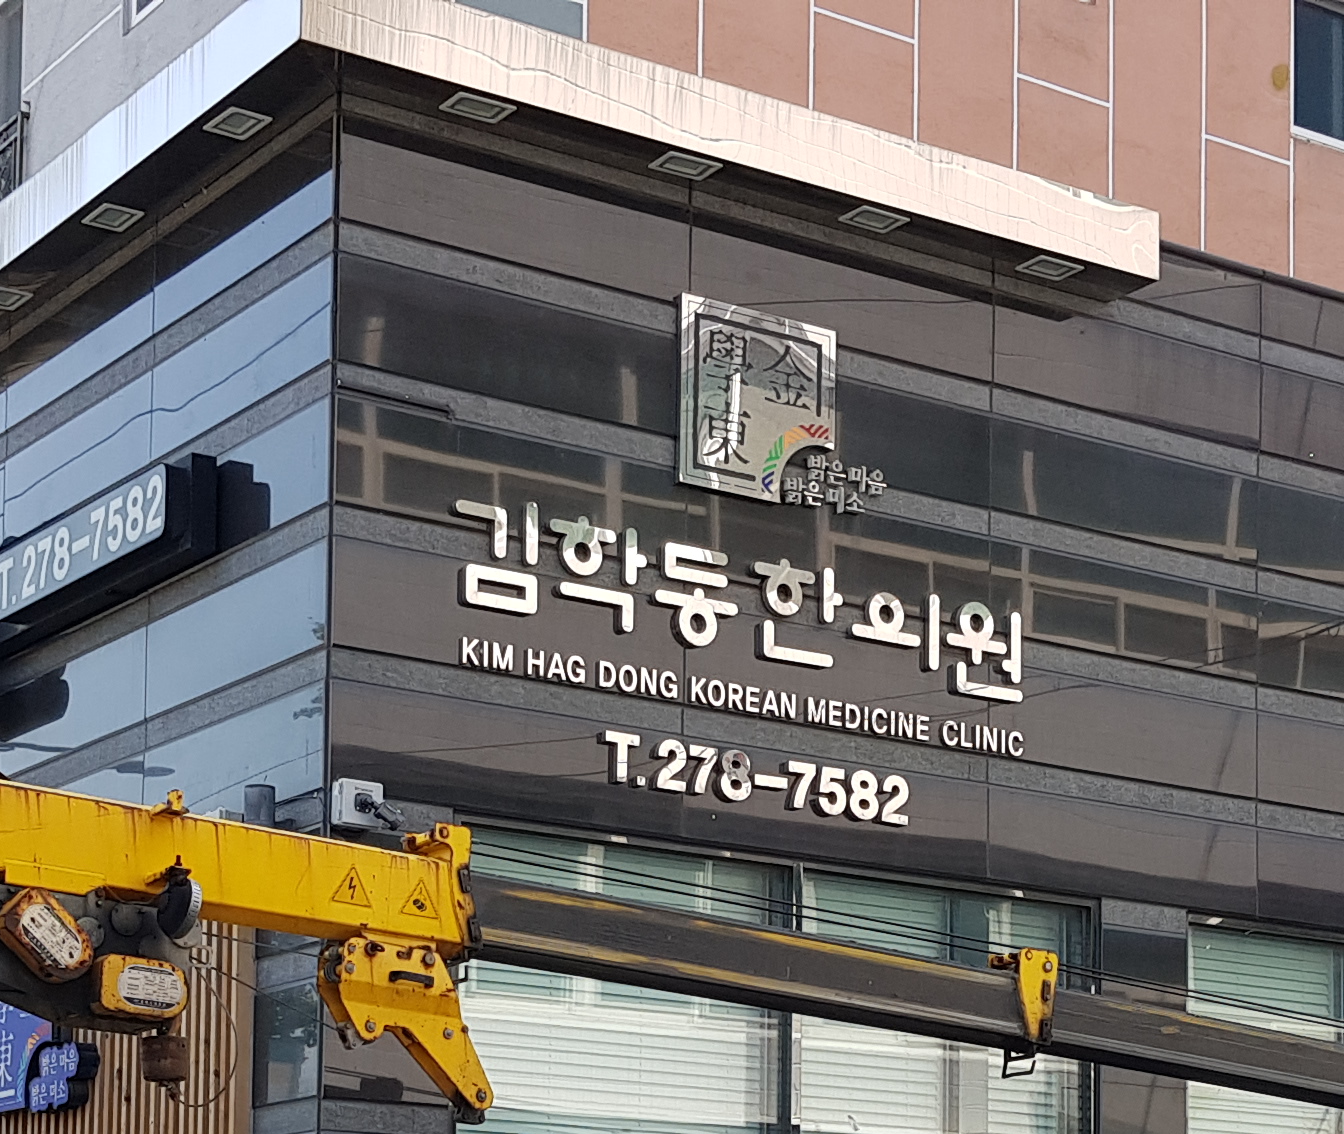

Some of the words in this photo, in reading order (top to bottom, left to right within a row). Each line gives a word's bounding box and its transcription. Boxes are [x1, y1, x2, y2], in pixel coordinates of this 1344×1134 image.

[783, 477, 824, 506] 밝은
[825, 486, 866, 514] 미소
[807, 454, 847, 485] 밝은
[847, 465, 887, 495] 마음
[455, 500, 1025, 703] 김학동한의원
[460, 636, 515, 672] KIM
[527, 648, 587, 684] HAG
[598, 660, 680, 699] DONG
[690, 675, 798, 721] KOREAN
[807, 696, 931, 742] MEDICINE
[942, 720, 1026, 758] CLINIC
[602, 731, 911, 826] T.278-7582
